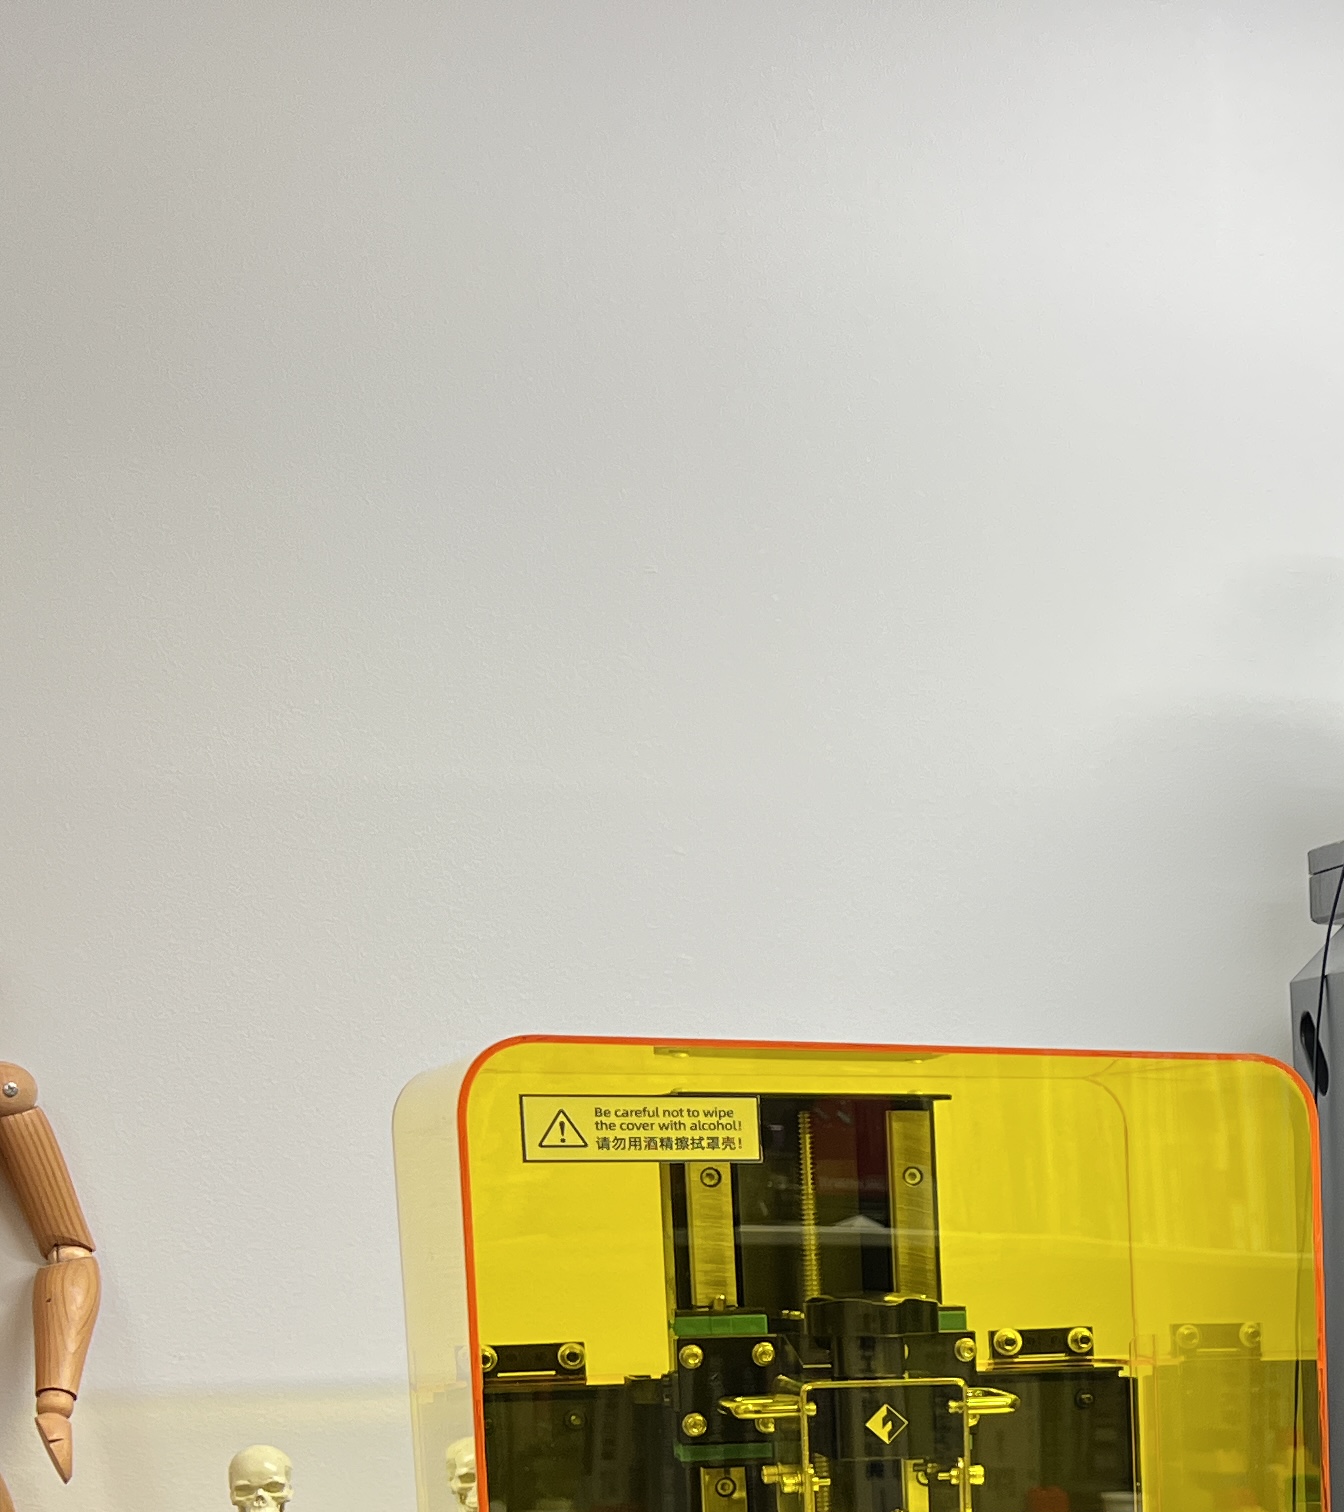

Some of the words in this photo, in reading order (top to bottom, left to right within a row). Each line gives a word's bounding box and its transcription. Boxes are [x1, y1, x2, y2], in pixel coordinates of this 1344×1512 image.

[594, 1107, 611, 1118] Be
[614, 1106, 659, 1118] careful
[662, 1108, 684, 1118] not
[687, 1108, 700, 1118] to
[703, 1107, 734, 1120] wipe
[595, 1120, 616, 1131] the
[619, 1121, 655, 1131] cover
[658, 1120, 686, 1131] with
[690, 1120, 742, 1131] alcohol!
